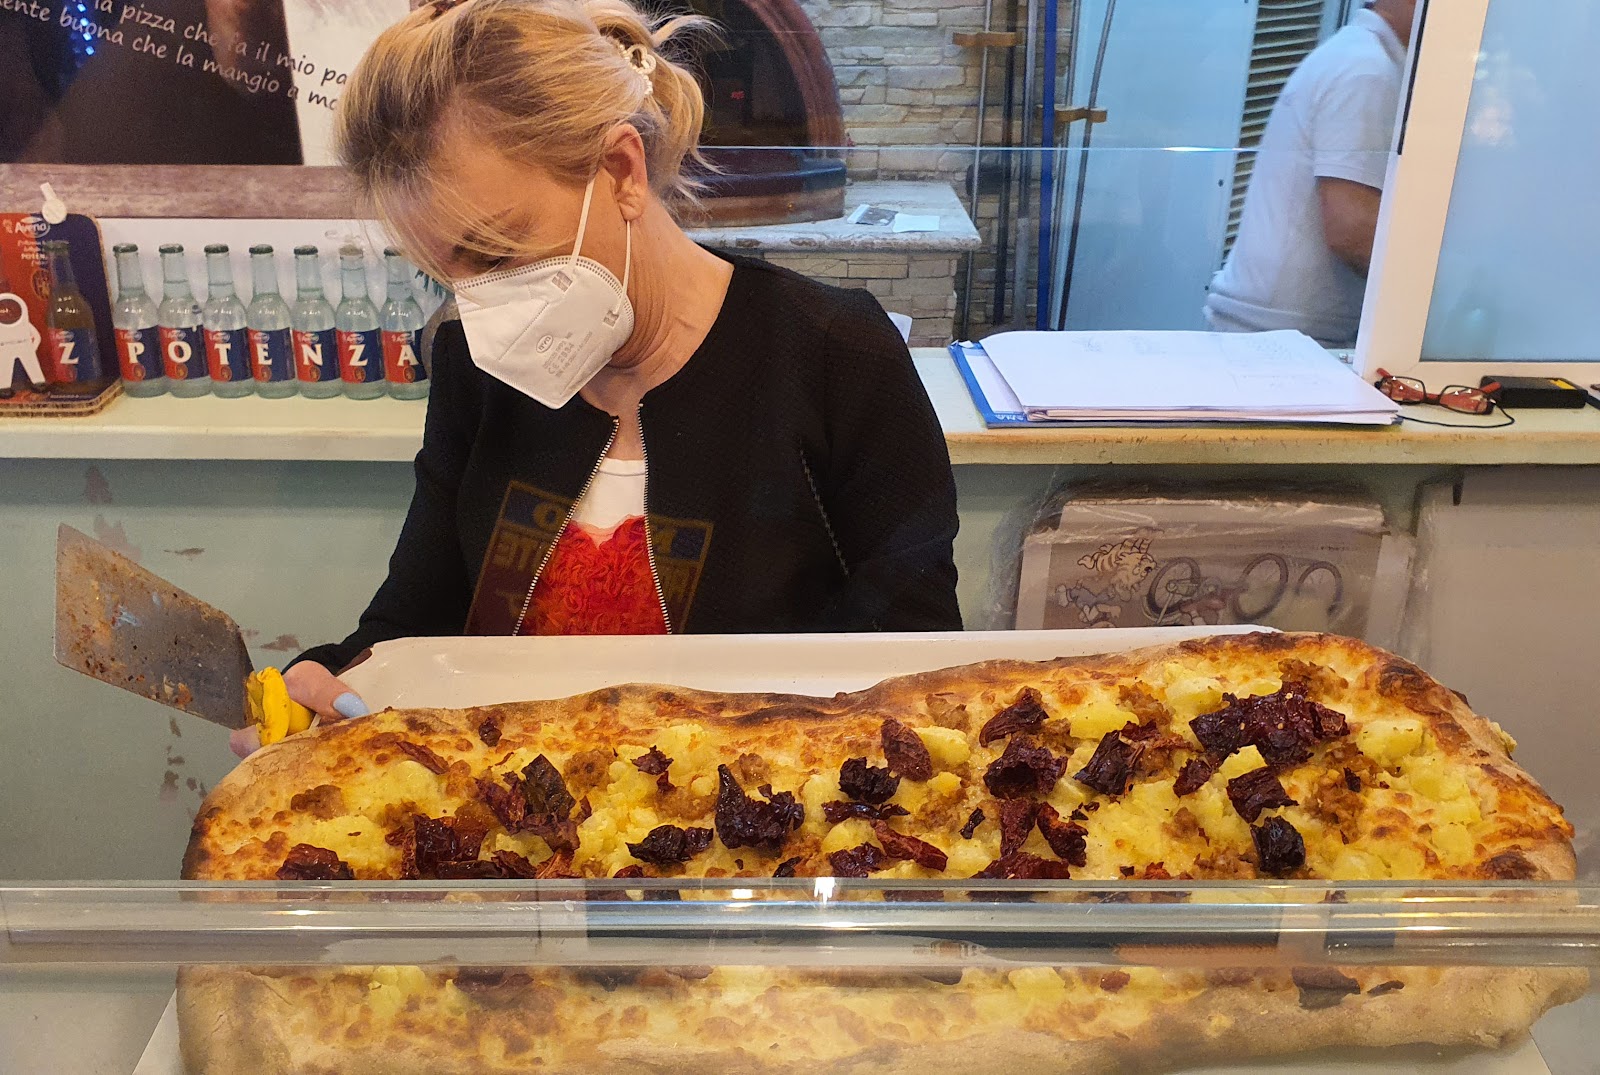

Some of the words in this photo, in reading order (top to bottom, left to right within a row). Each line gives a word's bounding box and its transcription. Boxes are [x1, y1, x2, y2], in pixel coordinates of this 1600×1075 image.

[0, 0, 50, 21] ente
[60, 6, 123, 45] buona
[132, 35, 168, 58] che
[176, 45, 194, 67] la
[203, 59, 280, 93] mangio
[287, 86, 299, 99] a
[120, 3, 175, 33] pizza
[184, 22, 218, 46] che
[256, 41, 270, 61] il
[276, 53, 315, 75] mio
[59, 341, 79, 364] Z
